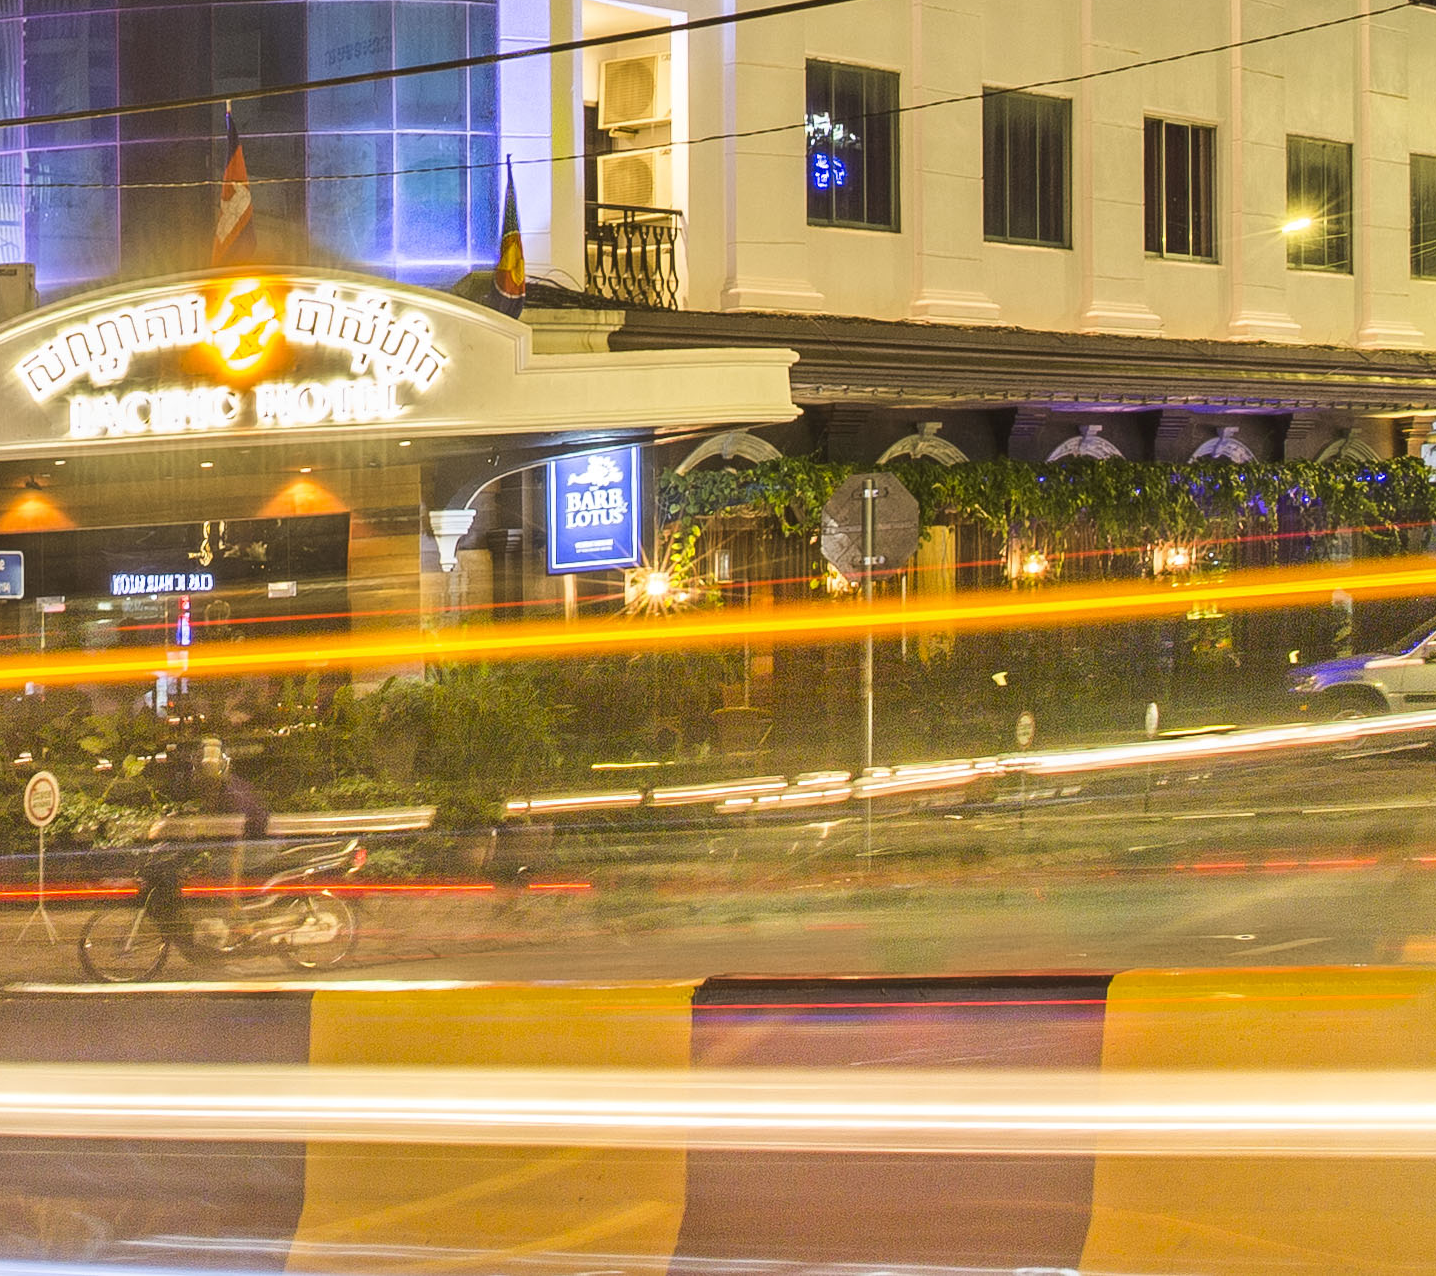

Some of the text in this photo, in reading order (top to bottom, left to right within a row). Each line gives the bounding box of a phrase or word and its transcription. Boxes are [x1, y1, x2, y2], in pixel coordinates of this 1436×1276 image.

[254, 381, 406, 426] HOTEL
[565, 488, 622, 512] BARB
[565, 509, 624, 529] LOTUS
